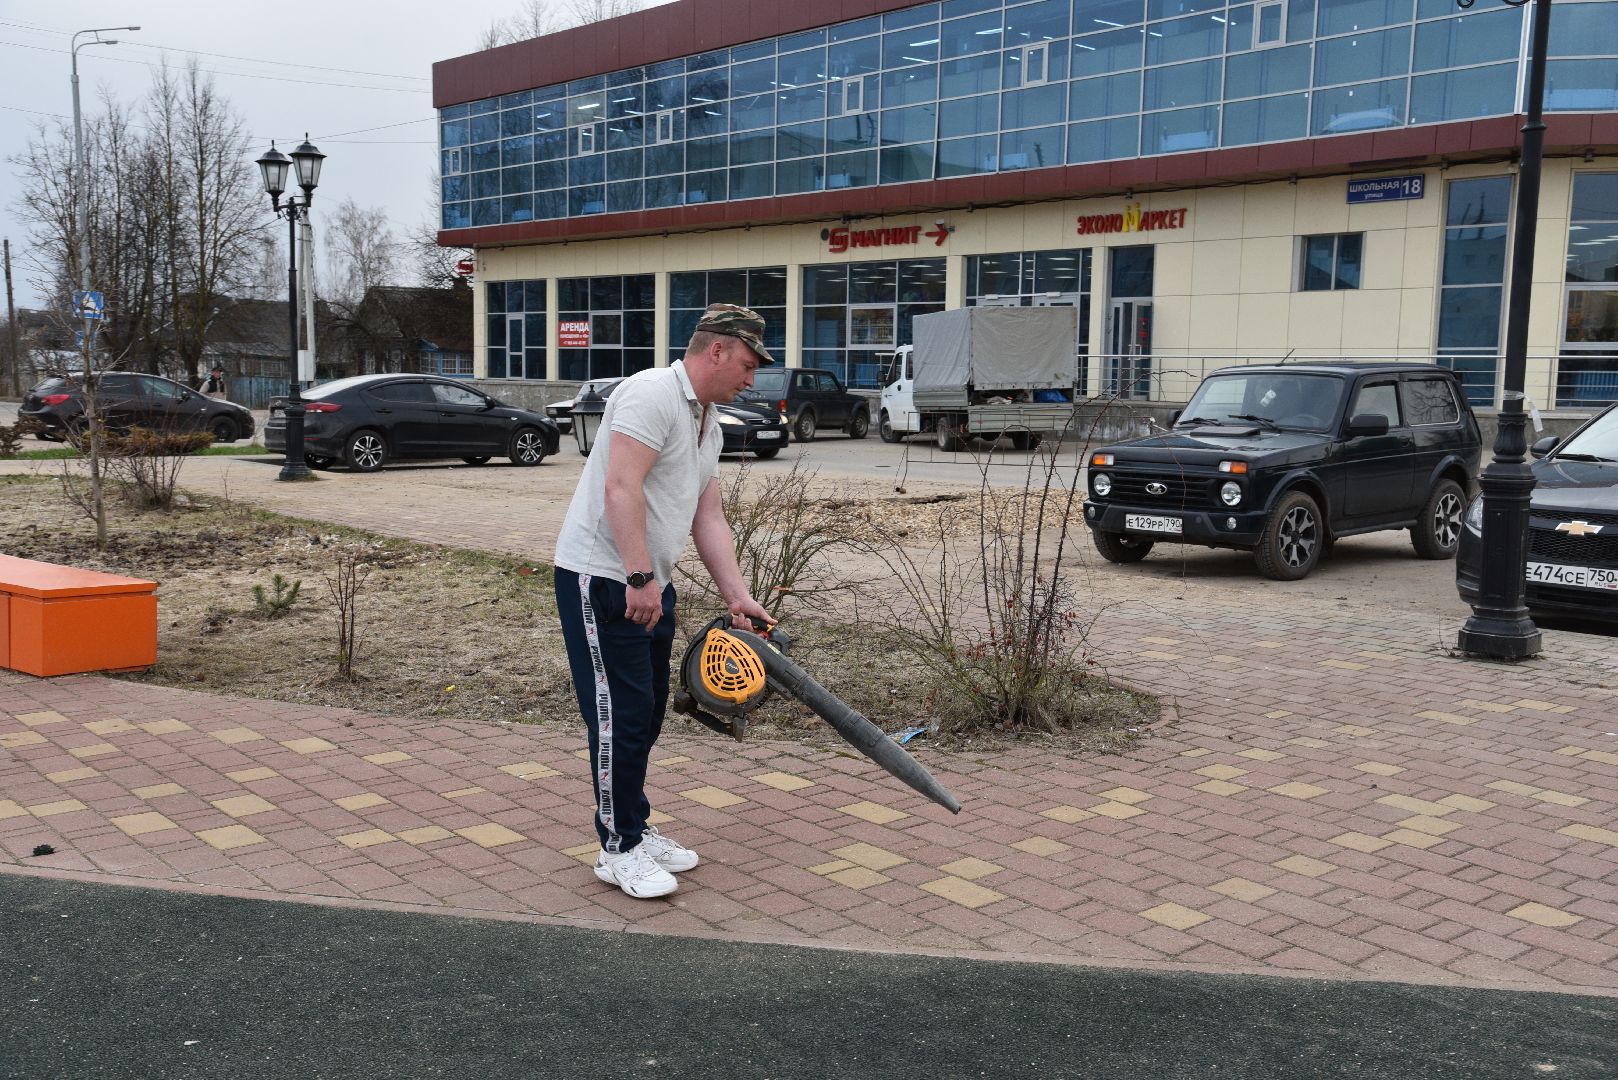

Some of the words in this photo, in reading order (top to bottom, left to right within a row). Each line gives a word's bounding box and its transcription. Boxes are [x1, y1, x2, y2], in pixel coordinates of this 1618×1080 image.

[1349, 181, 1400, 193] ШКОЛЬНАЯ
[1402, 179, 1421, 195] 18
[1077, 201, 1188, 236] ЭКОНОМАРКЕТ
[850, 226, 922, 248] МАГНИТ
[560, 323, 589, 333] АРЕНДА
[1165, 518, 1181, 529] 790
[1589, 569, 1615, 583] 750
[598, 693, 610, 722] PUMA
